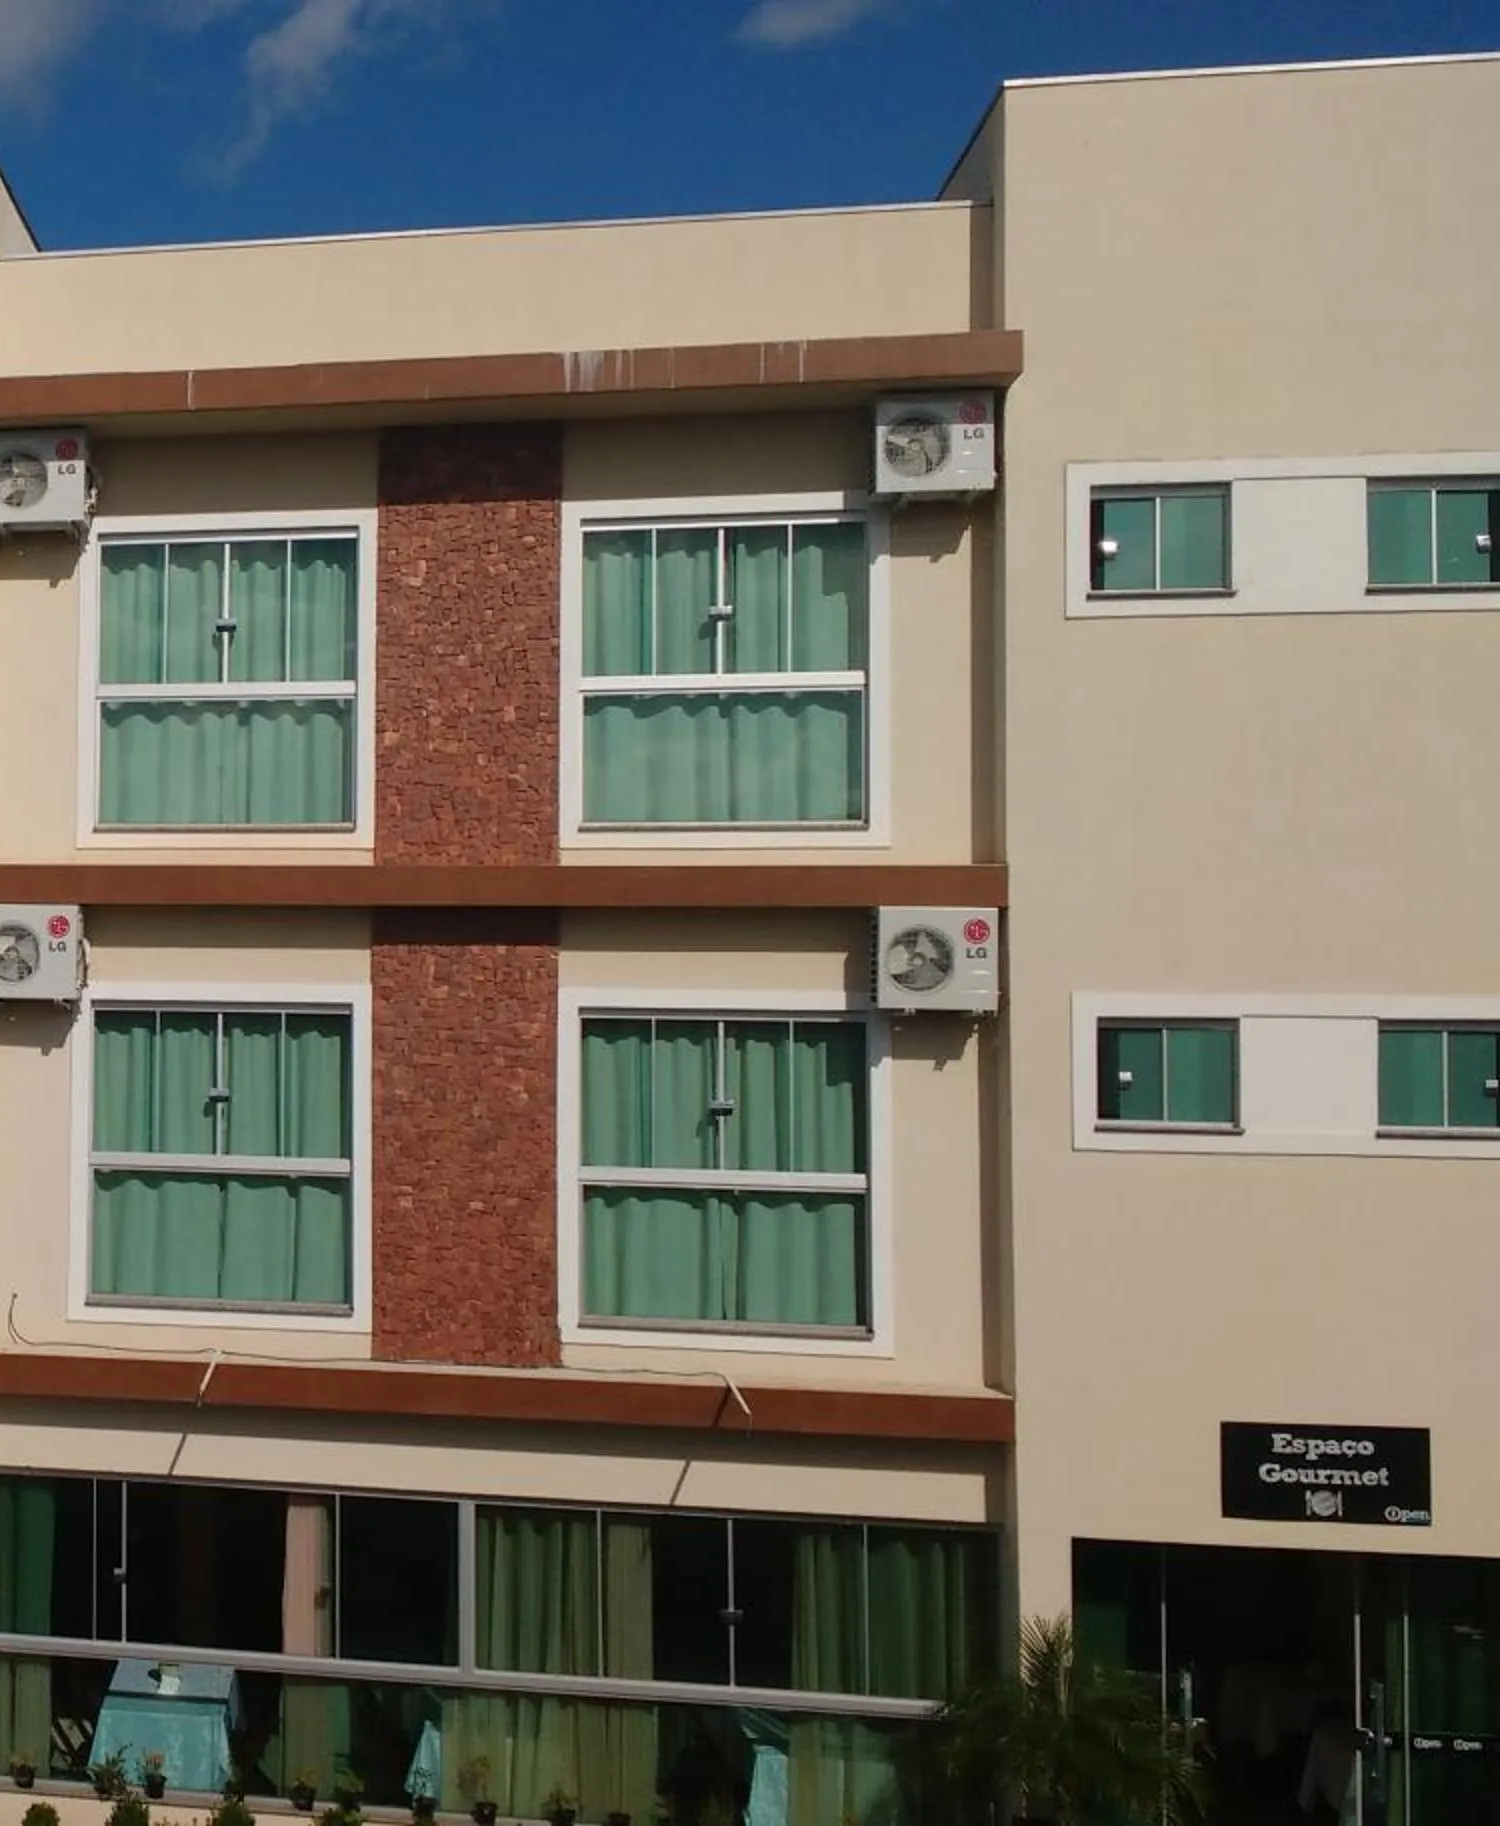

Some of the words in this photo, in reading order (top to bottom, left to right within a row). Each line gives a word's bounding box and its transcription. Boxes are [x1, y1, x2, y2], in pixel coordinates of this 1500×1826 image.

[964, 427, 984, 440] LG
[57, 463, 77, 475] LG
[48, 941, 67, 952] LG
[965, 947, 987, 959] LG
[1271, 1432, 1375, 1460] Espaço
[1258, 1462, 1389, 1486] Gourmet
